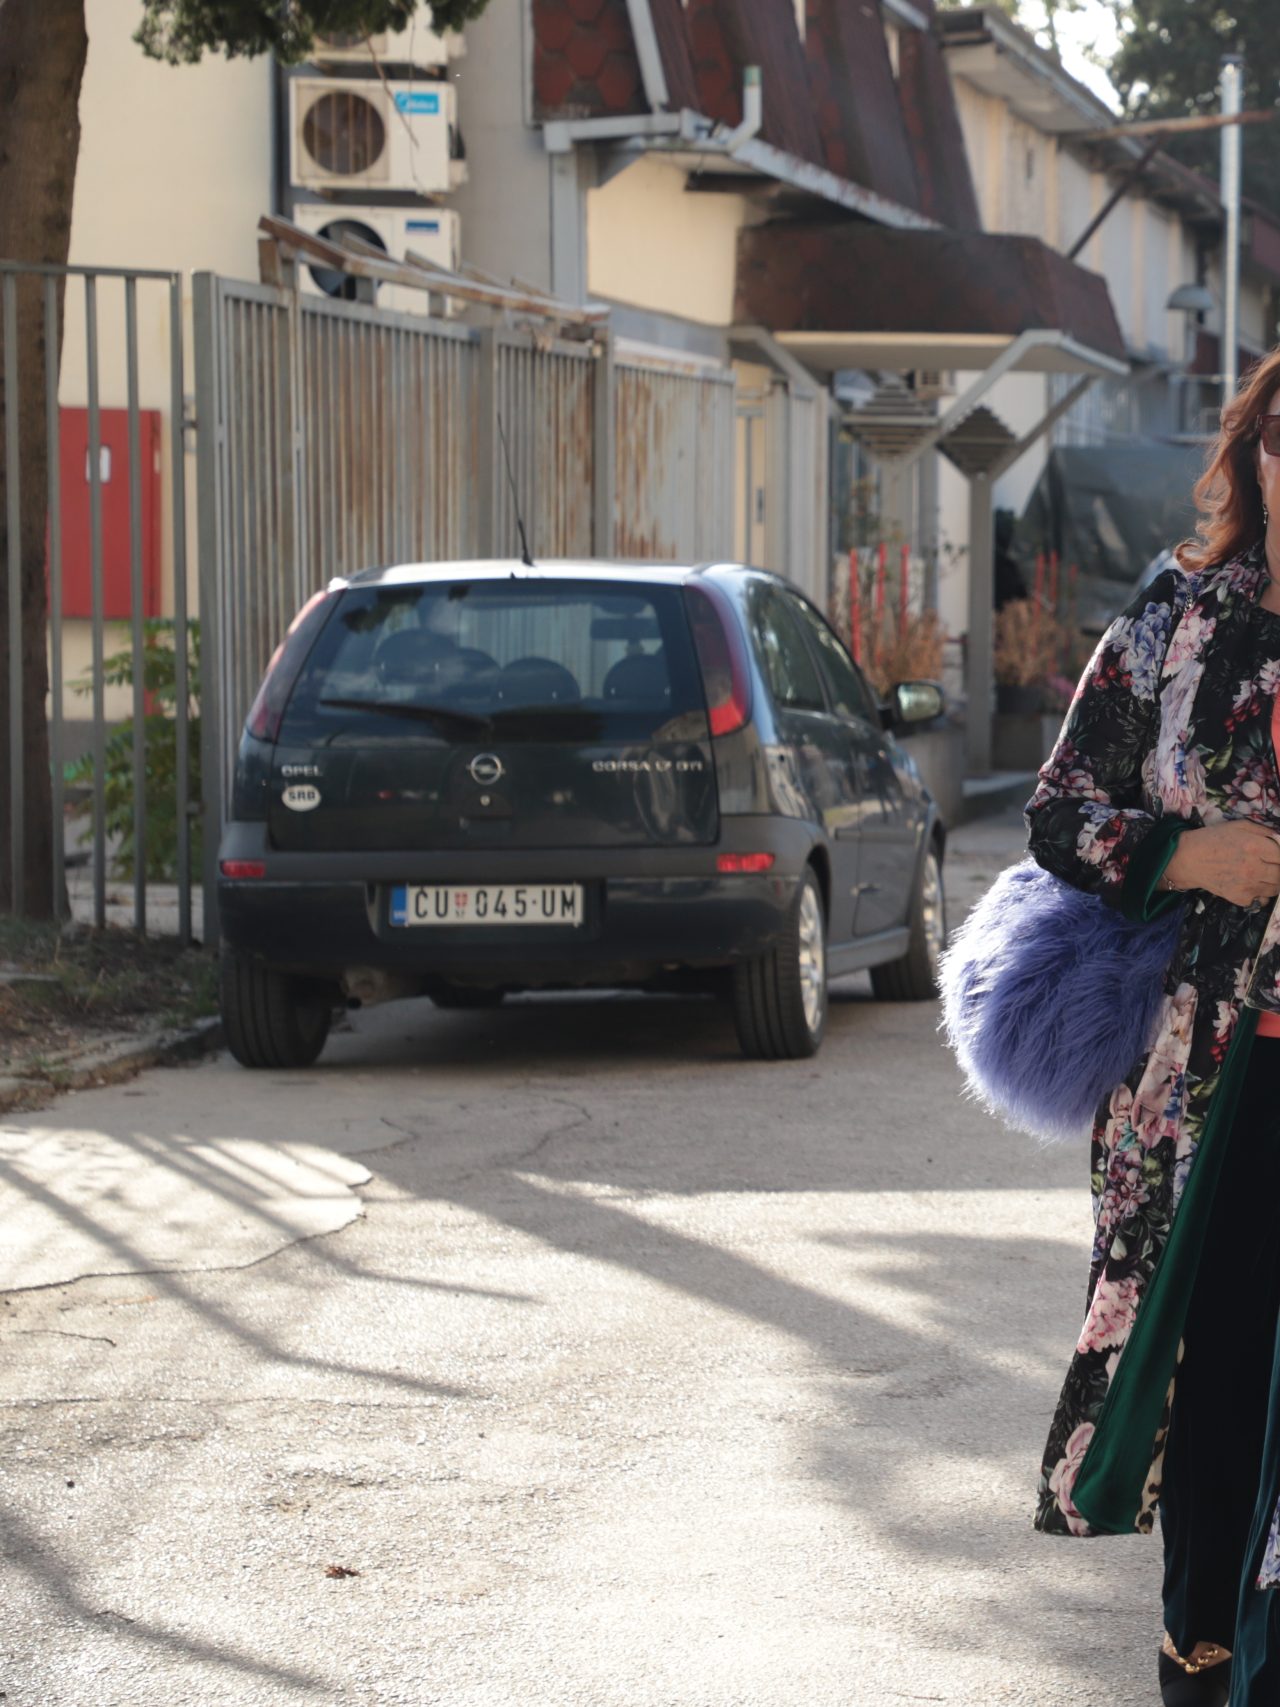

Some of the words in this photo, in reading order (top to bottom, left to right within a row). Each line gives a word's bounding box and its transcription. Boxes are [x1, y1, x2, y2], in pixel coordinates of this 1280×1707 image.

[281, 764, 323, 777] OPEL
[592, 760, 650, 772] CORSA
[288, 791, 316, 802] SRB
